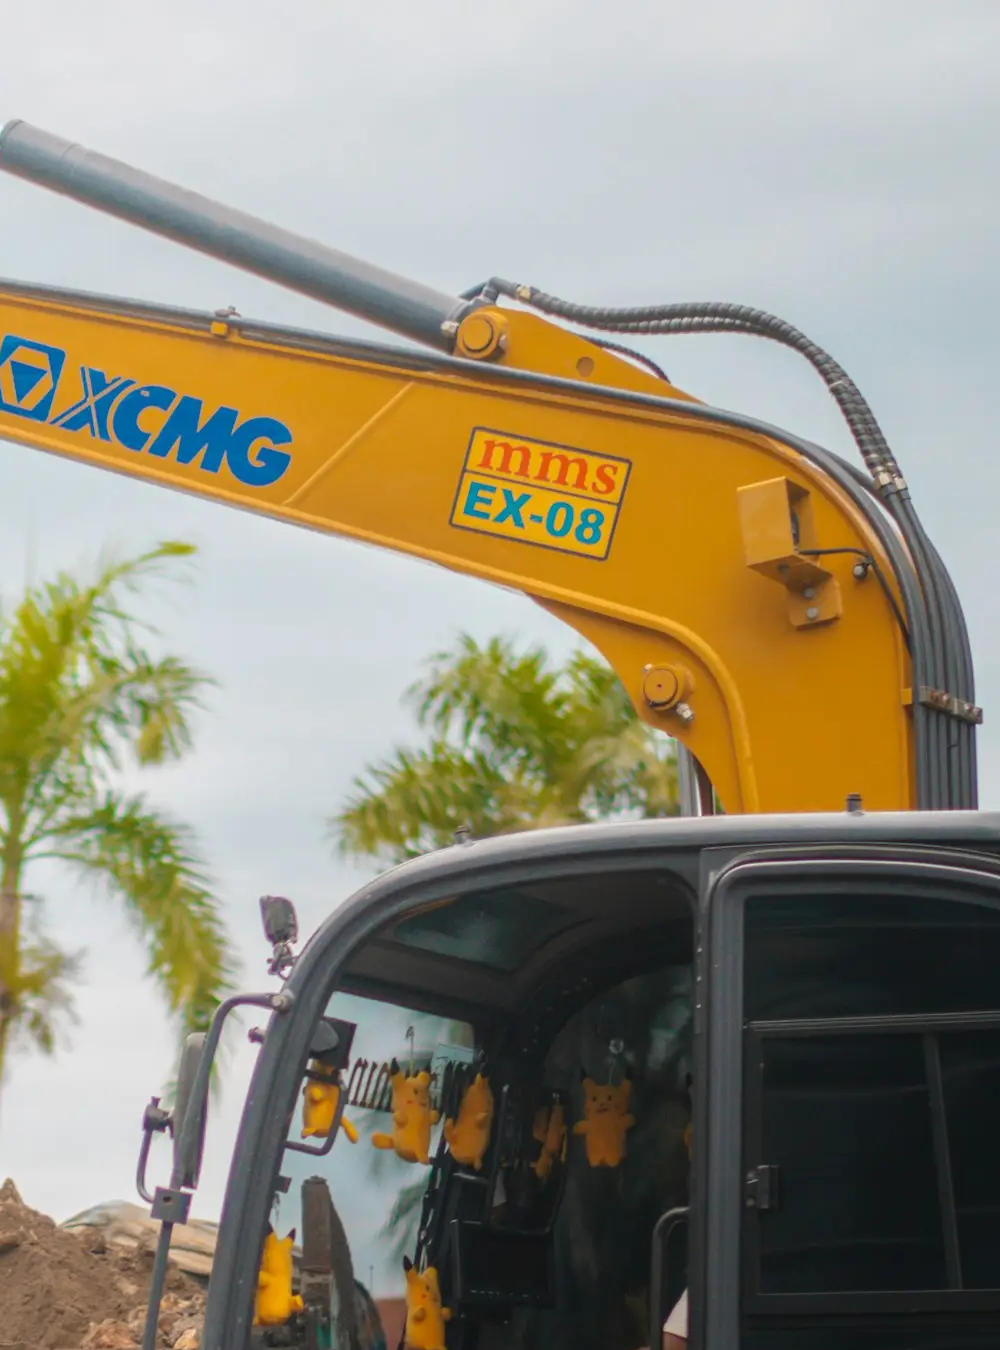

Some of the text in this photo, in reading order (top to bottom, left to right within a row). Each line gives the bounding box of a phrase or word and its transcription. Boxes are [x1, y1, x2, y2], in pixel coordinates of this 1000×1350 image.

[49, 366, 292, 487] XCMG
[479, 437, 618, 496] mms
[463, 480, 604, 545] EX-08
